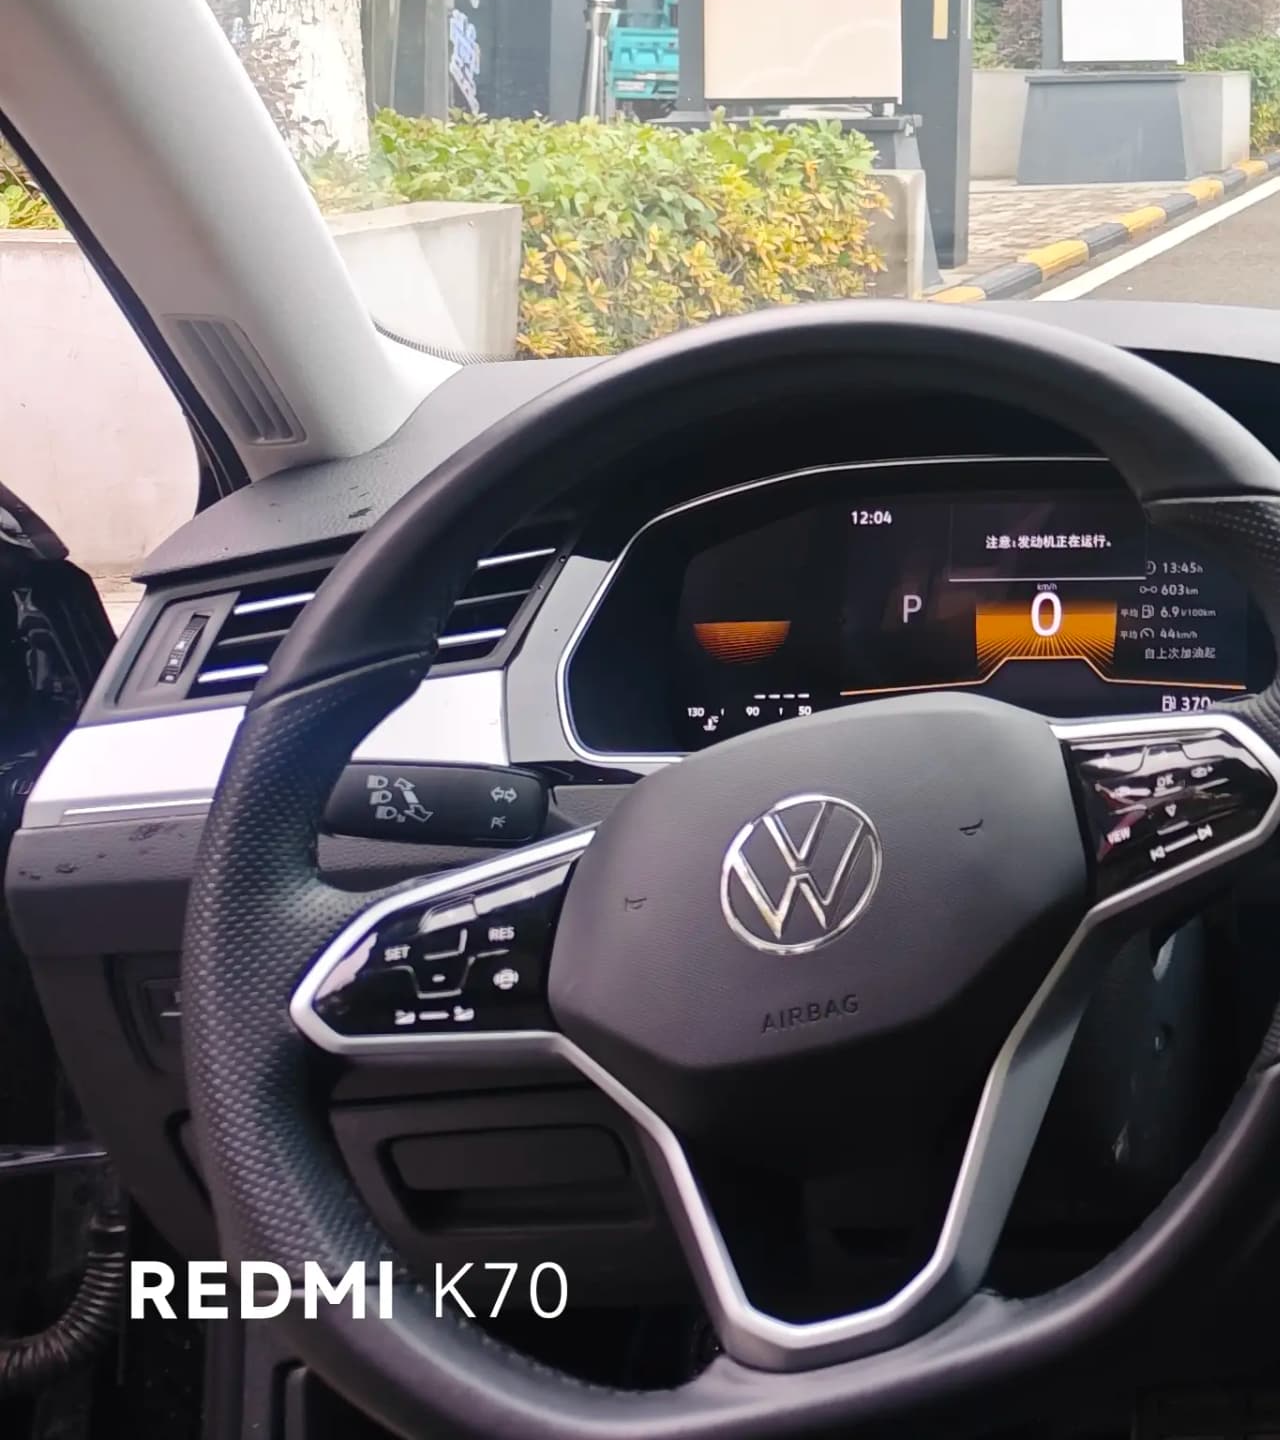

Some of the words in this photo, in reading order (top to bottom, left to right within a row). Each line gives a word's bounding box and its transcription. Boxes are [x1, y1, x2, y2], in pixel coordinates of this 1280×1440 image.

[851, 510, 893, 525] 12:04
[1036, 582, 1058, 591] km/h
[901, 594, 923, 625] P
[1031, 591, 1062, 637] 0
[1120, 608, 1138, 618] 平均
[1120, 630, 1138, 640] 平均
[1144, 647, 1217, 659] 自上次加油起
[1181, 696, 1213, 711] 370
[687, 707, 705, 717] 130
[745, 706, 760, 716] 90
[798, 706, 812, 716] 50
[487, 926, 515, 942] RES
[384, 944, 412, 962] SET
[760, 993, 860, 1034] AIRBAG
